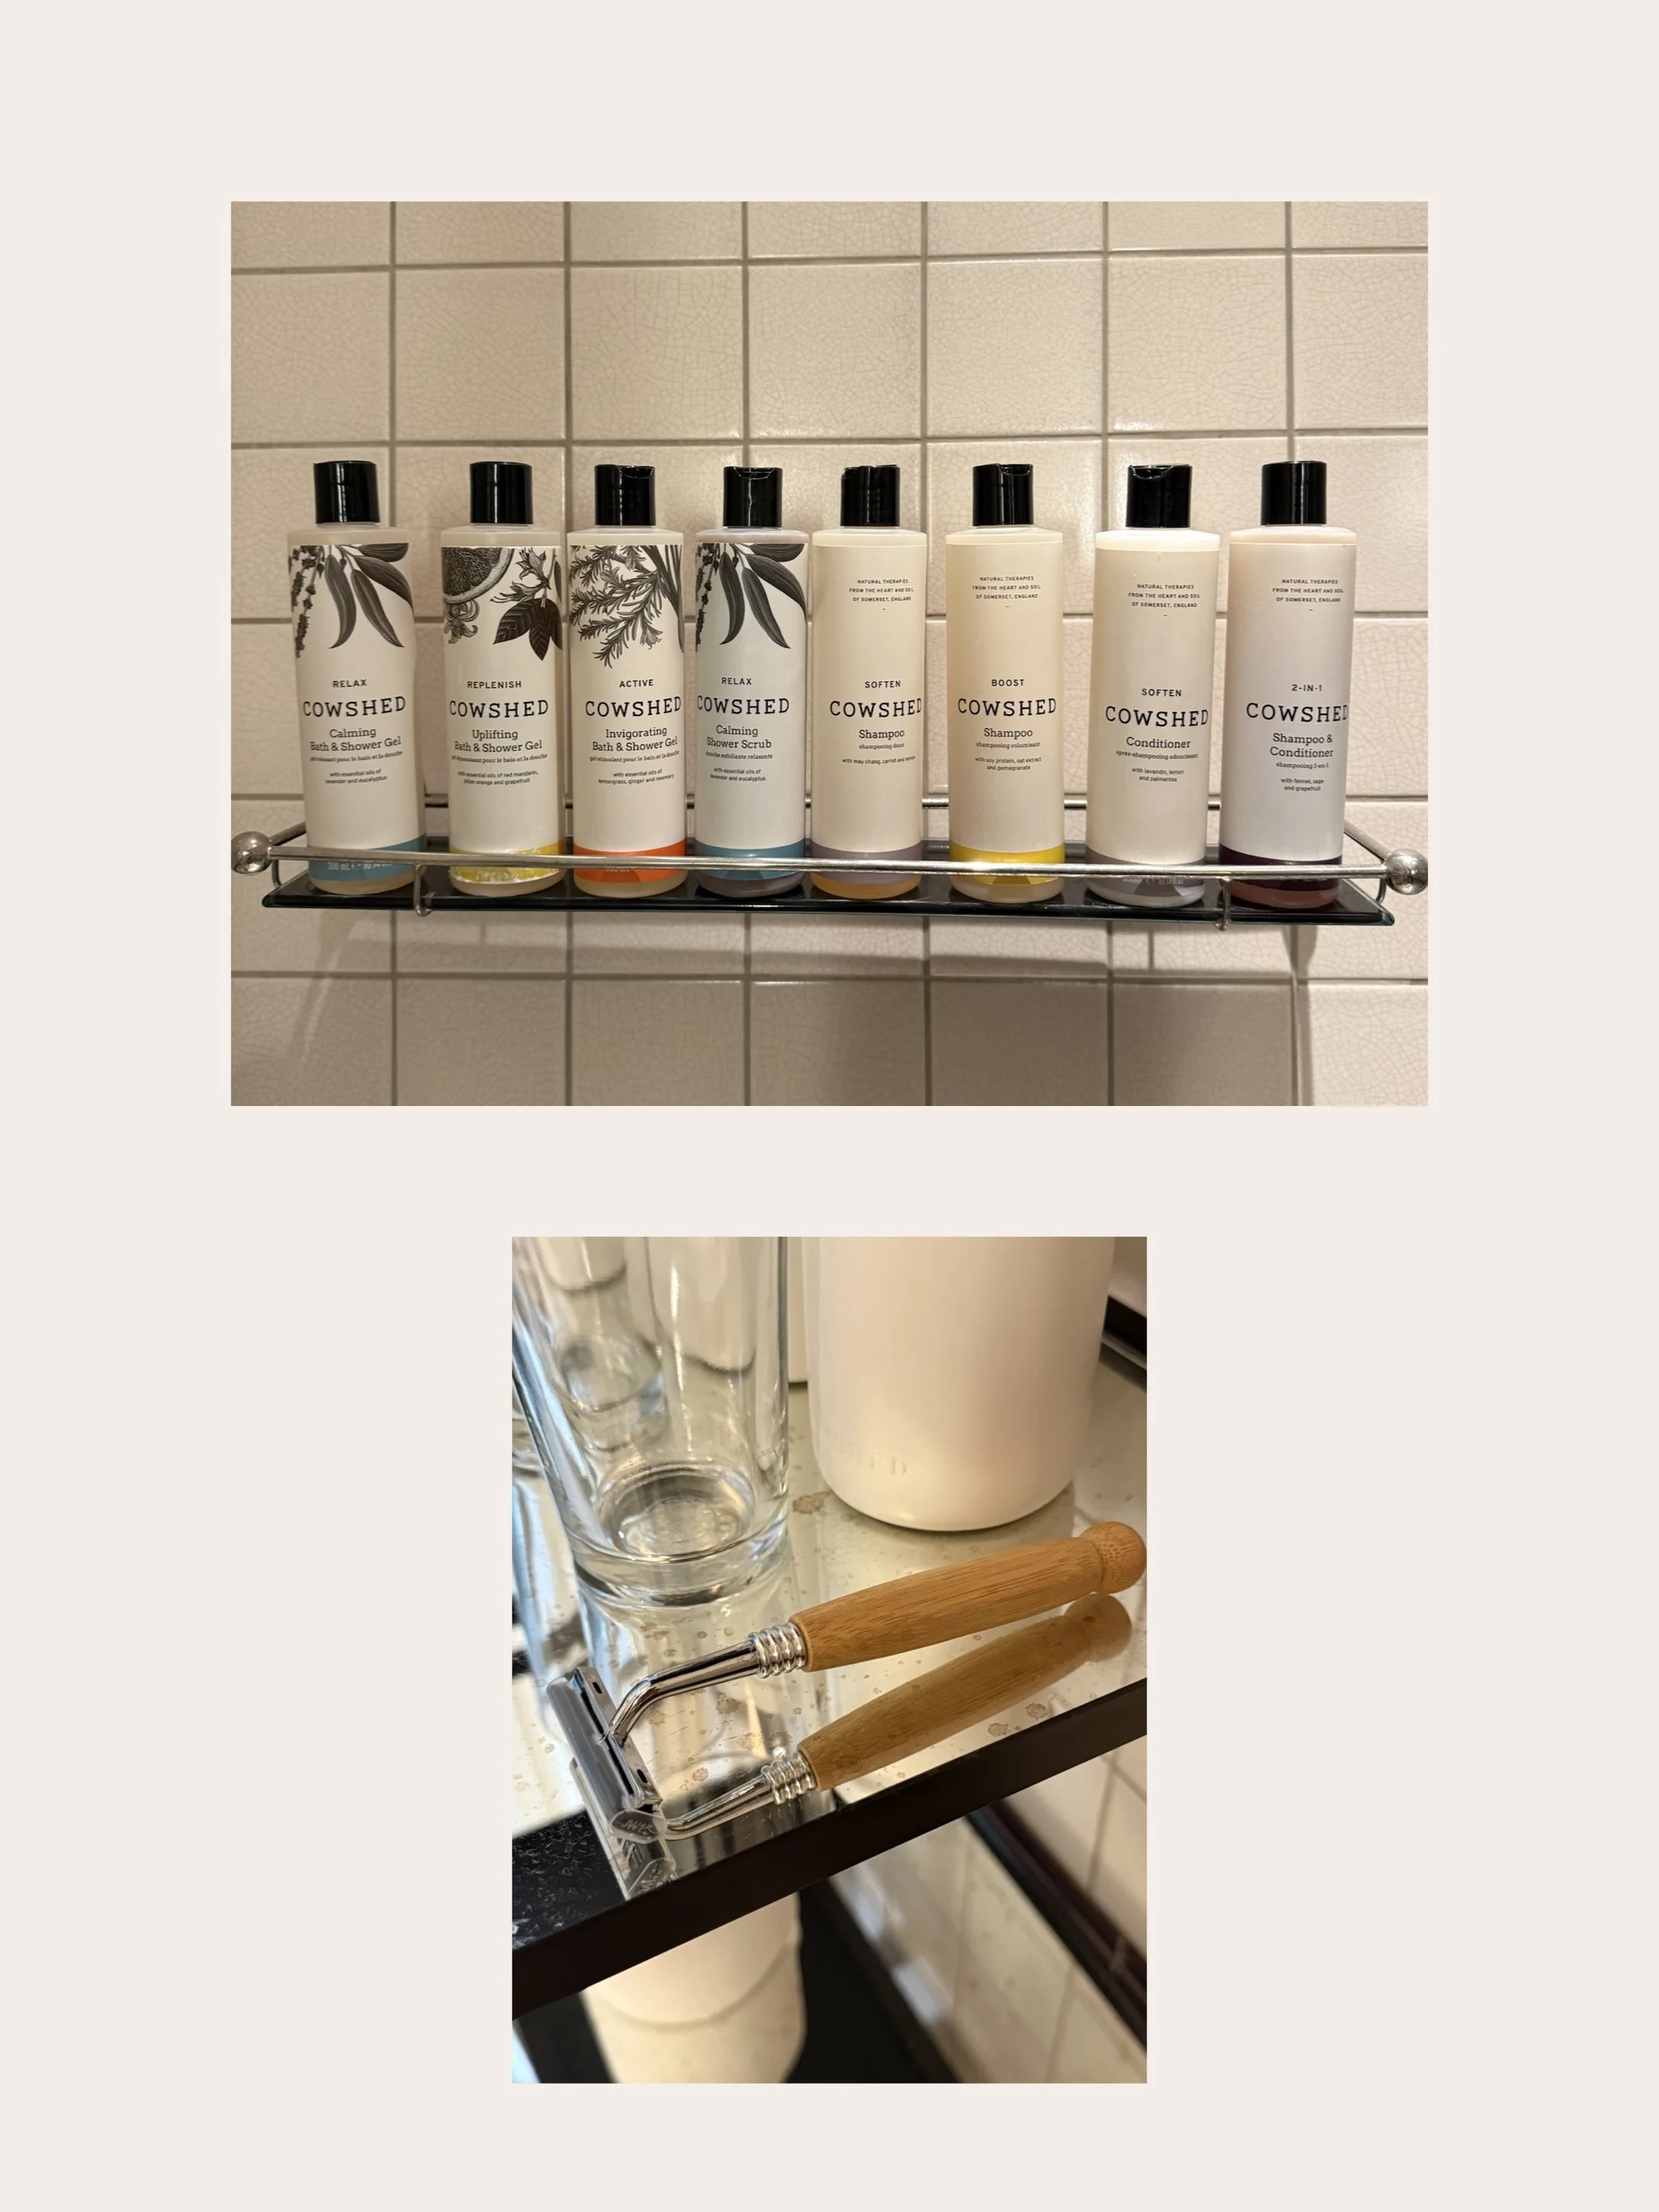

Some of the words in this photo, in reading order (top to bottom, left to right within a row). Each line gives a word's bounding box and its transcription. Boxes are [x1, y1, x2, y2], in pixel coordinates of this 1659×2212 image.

[333, 679, 367, 687] RELAX
[467, 680, 522, 689] REPLENISH
[619, 679, 654, 688] ACTIVE
[1141, 688, 1182, 697] SOFTEN
[303, 696, 406, 717] COWSHED
[449, 700, 548, 718] COWSHED
[585, 696, 681, 717] COWSHED
[697, 695, 790, 714] COWSHED
[830, 697, 922, 718] COWSHED
[958, 698, 1056, 717] COWSHED
[1105, 705, 1209, 727] COWSHED
[1247, 702, 1349, 723] COWSHED
[329, 728, 376, 738] Calming
[472, 730, 518, 741] Uplifting
[606, 727, 667, 740] Invigorating
[716, 725, 758, 737] Calming
[859, 729, 905, 740] Shampoo
[983, 727, 1033, 740] Shampoo
[310, 741, 329, 751] Bath
[331, 742, 339, 751] &
[340, 740, 382, 751] Shower
[384, 736, 402, 747] Gel
[592, 741, 614, 751] Bath
[616, 742, 624, 751] &
[625, 740, 664, 751] Shower
[664, 736, 677, 747] Gel
[707, 737, 739, 748] Shower
[741, 740, 772, 749] Scrub
[1126, 737, 1191, 748] Conditioner
[1273, 733, 1325, 746] Shampoo
[1326, 734, 1333, 743] &
[455, 741, 471, 752] Bath
[473, 743, 481, 752] &
[482, 743, 523, 753] Shower
[525, 740, 542, 750] Gel
[1270, 746, 1334, 758] Conditioner
